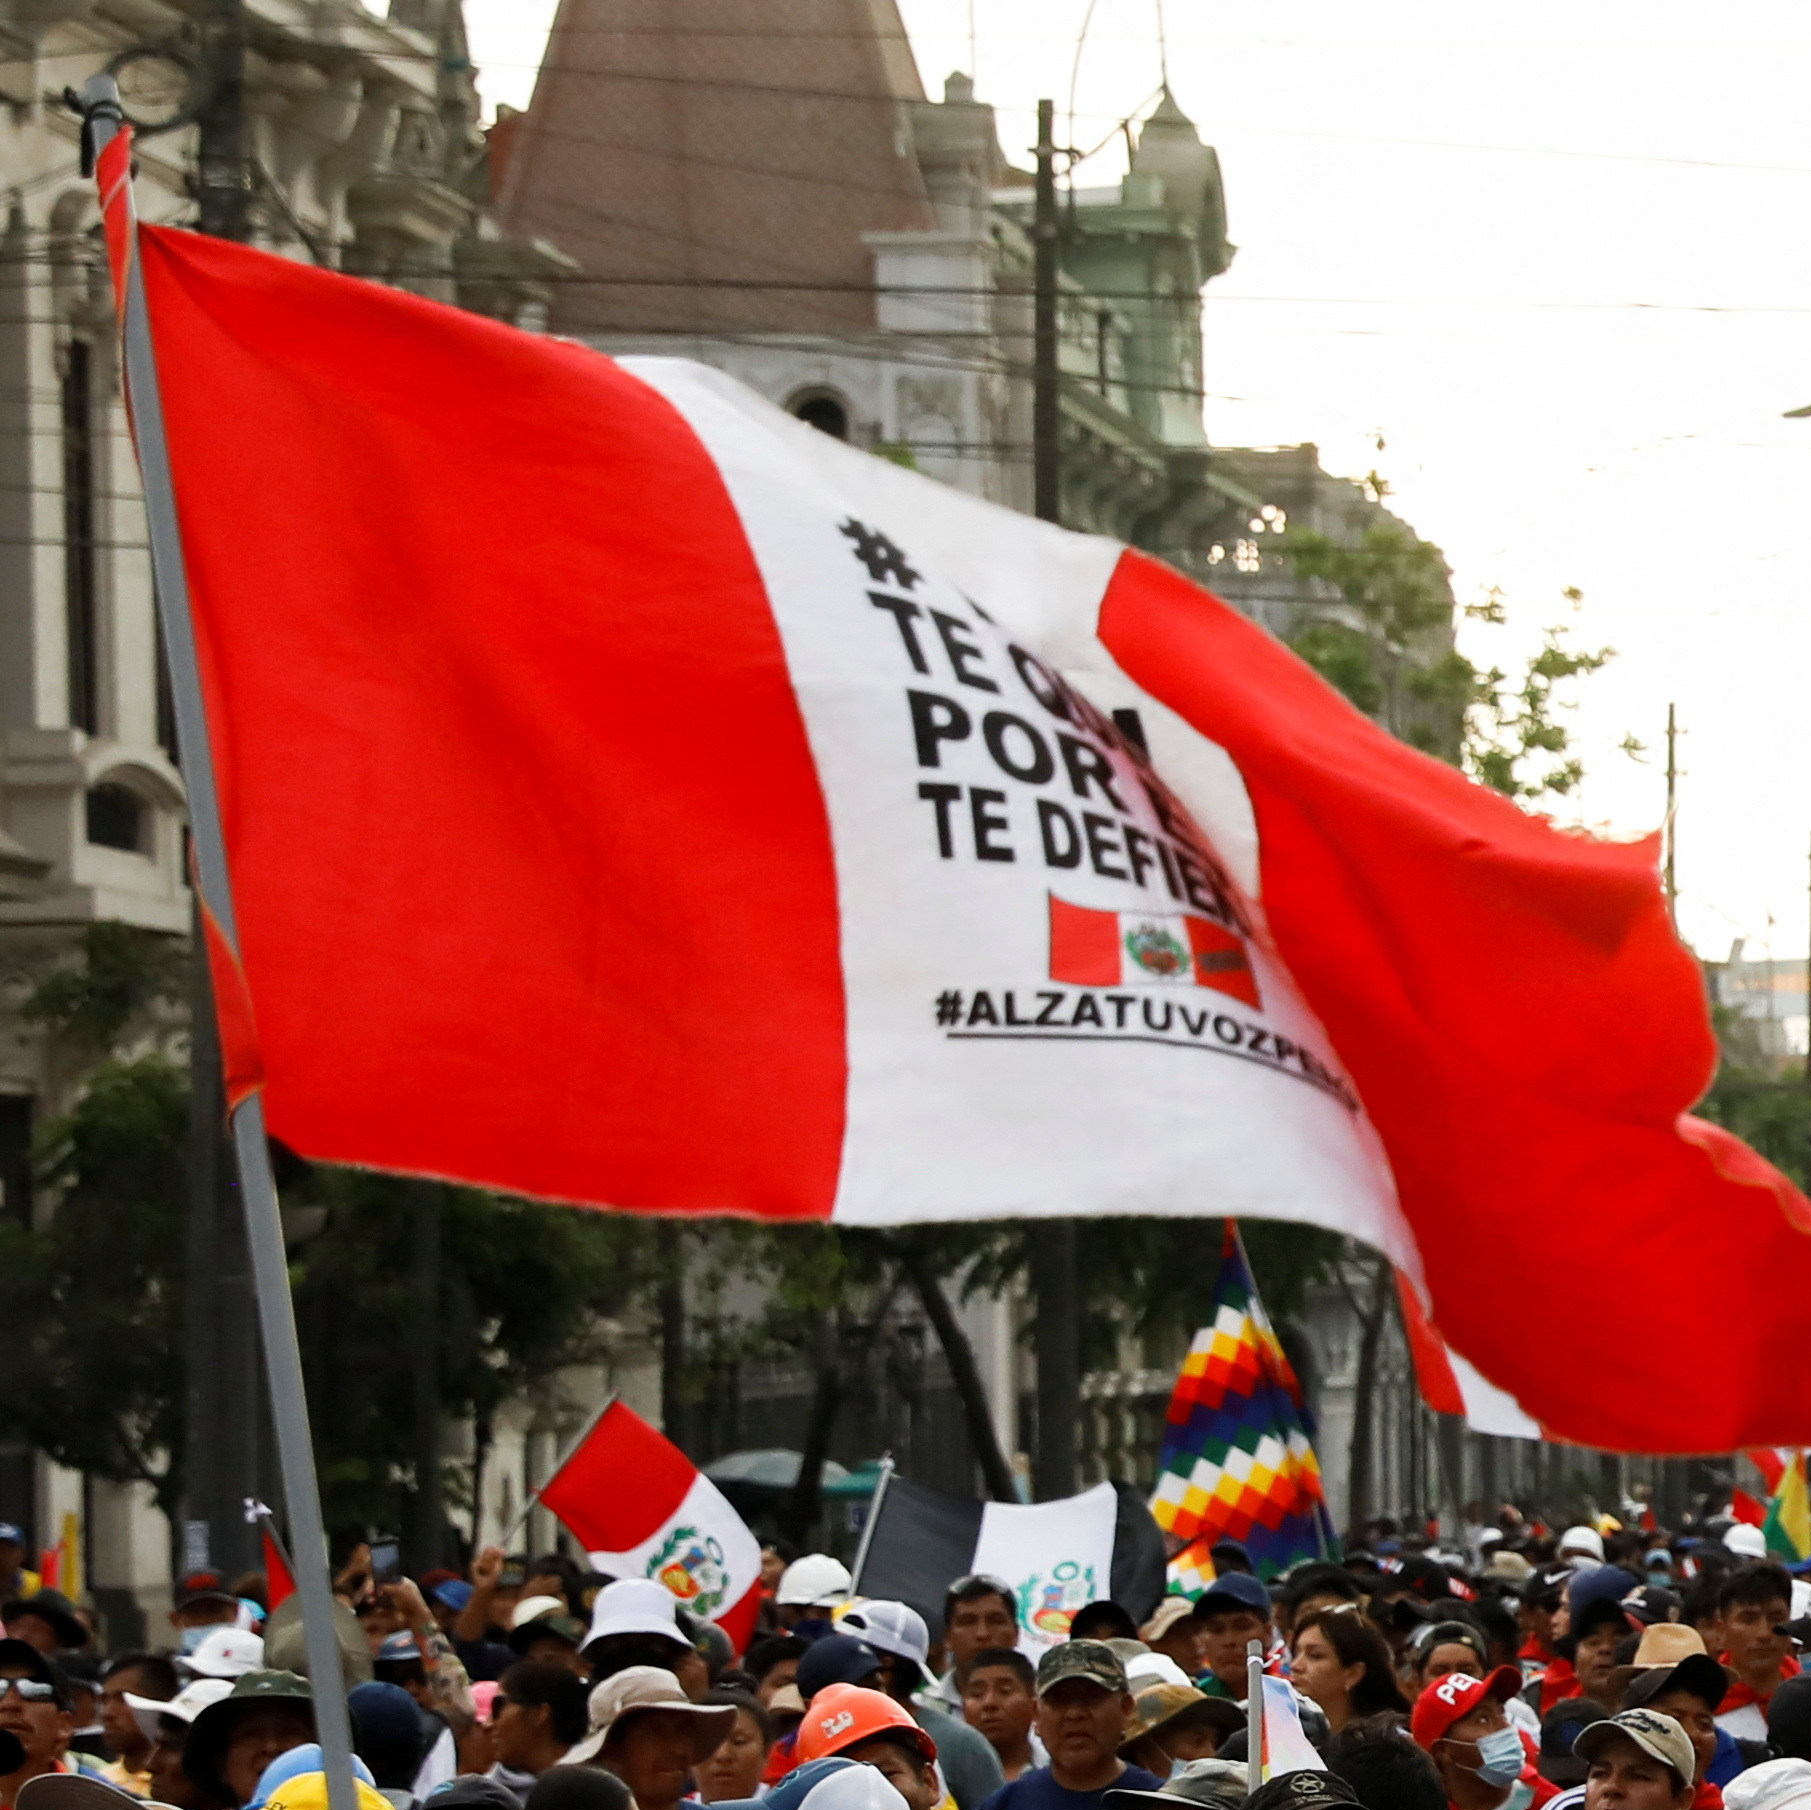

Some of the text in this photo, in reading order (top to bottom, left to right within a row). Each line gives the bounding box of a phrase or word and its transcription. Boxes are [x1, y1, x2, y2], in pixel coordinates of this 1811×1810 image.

[866, 590, 1001, 696] TE
[906, 687, 1132, 812] POR
[918, 782, 1016, 864] TE
[1436, 1672, 1484, 1706] PE
